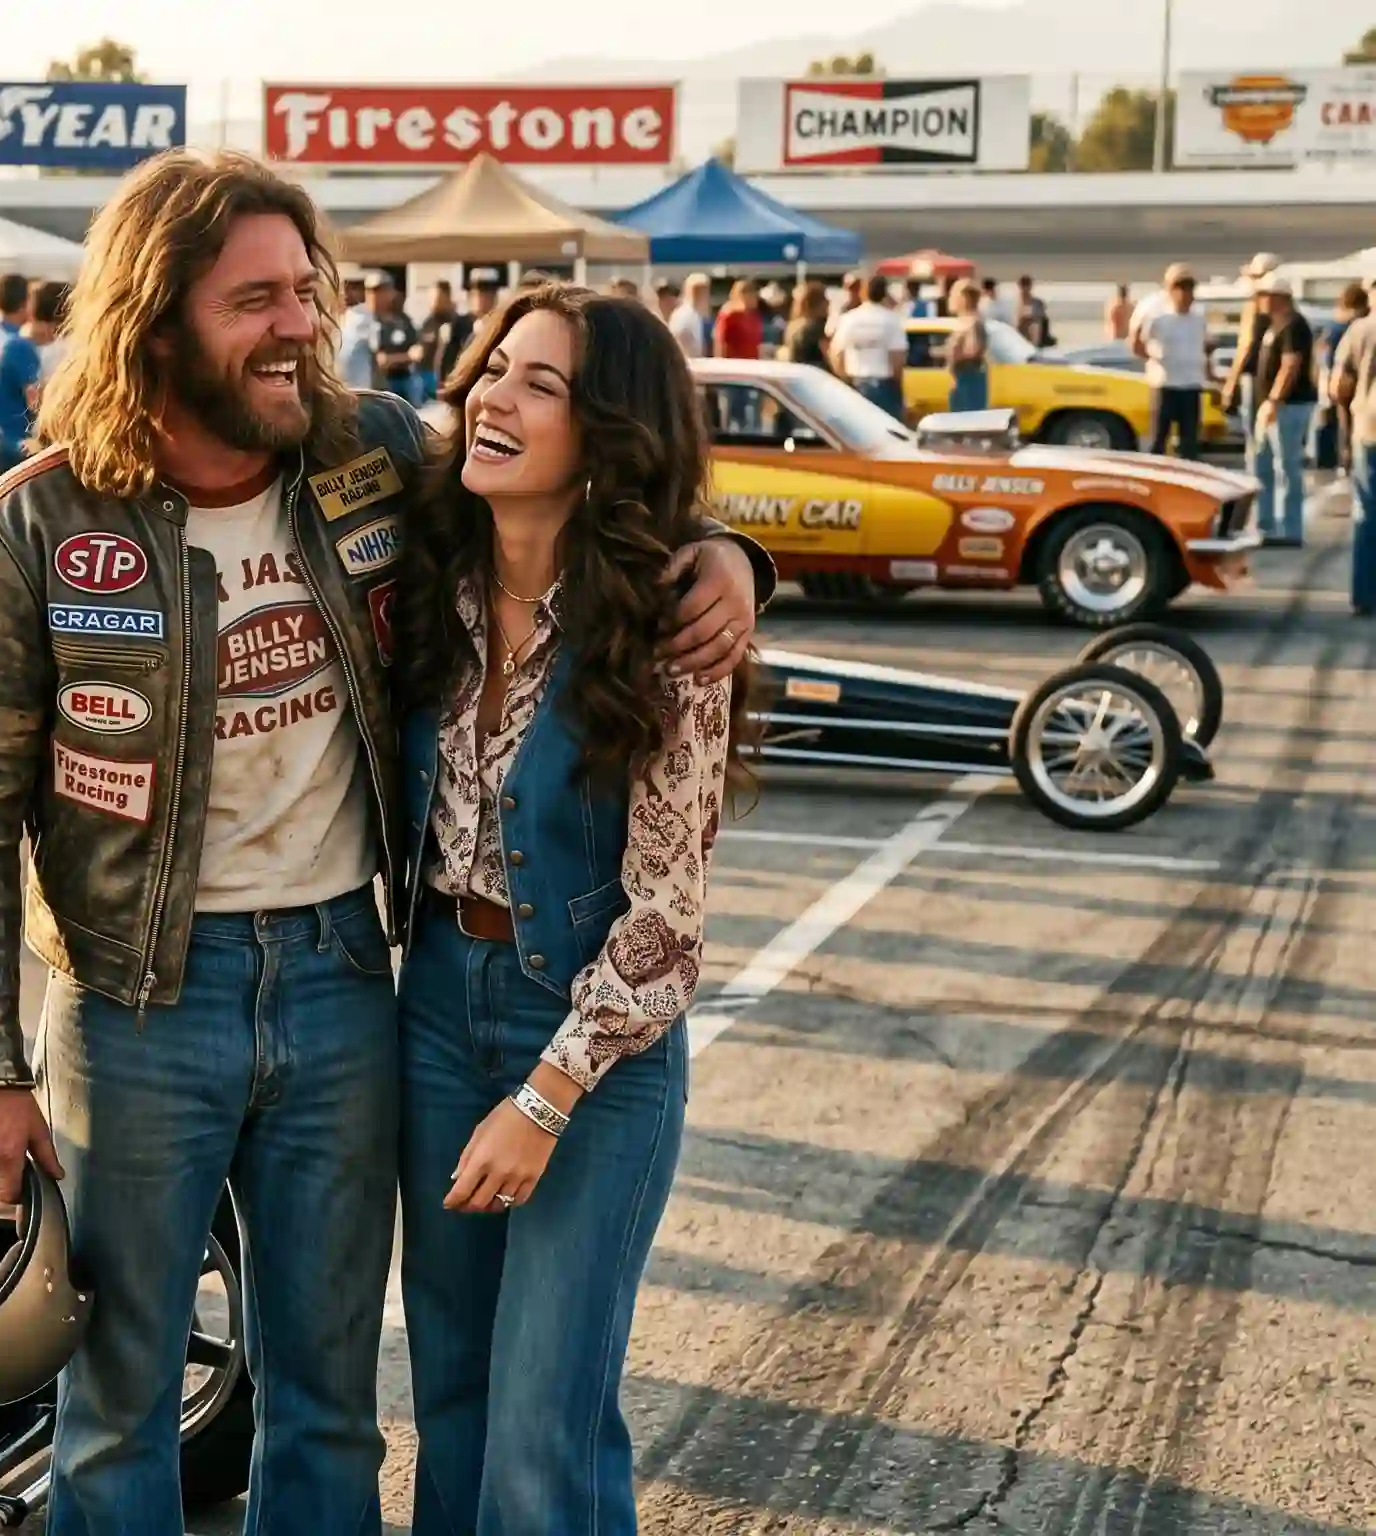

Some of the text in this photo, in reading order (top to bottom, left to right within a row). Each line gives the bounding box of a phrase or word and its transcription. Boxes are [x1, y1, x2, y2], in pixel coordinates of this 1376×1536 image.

[274, 92, 663, 158] Firestone
[795, 107, 968, 138] CHAMPION
[799, 499, 863, 530] CAR
[66, 539, 136, 584] STP
[52, 610, 156, 632] CRAGAR
[227, 614, 304, 660] BILLY
[218, 636, 326, 690] JENSEN
[71, 692, 136, 719] BELL
[56, 748, 146, 788] Firestone
[65, 773, 129, 810] Racing
